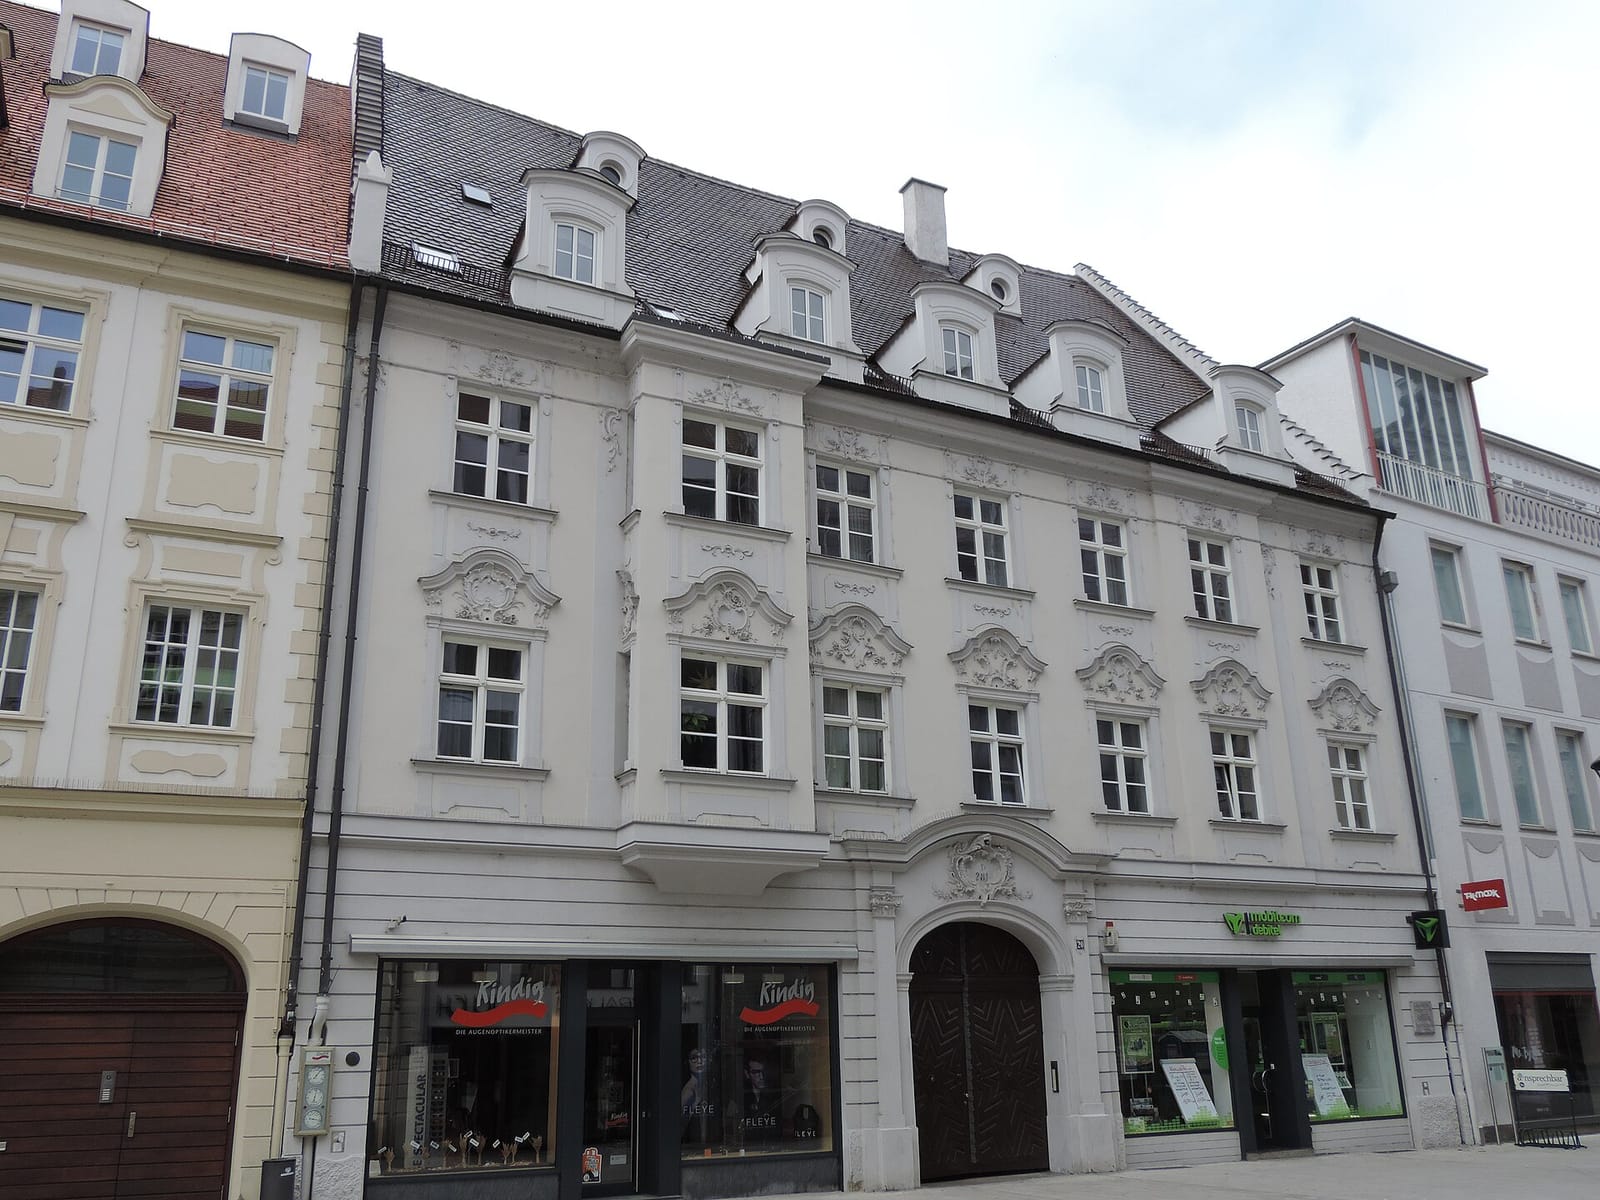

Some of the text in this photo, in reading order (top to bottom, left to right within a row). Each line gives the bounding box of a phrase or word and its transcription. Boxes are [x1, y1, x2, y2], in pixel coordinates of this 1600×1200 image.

[1250, 910, 1300, 923] mobilcom
[1252, 924, 1281, 936] debitel
[413, 1074, 426, 1155] SECTACULAR
